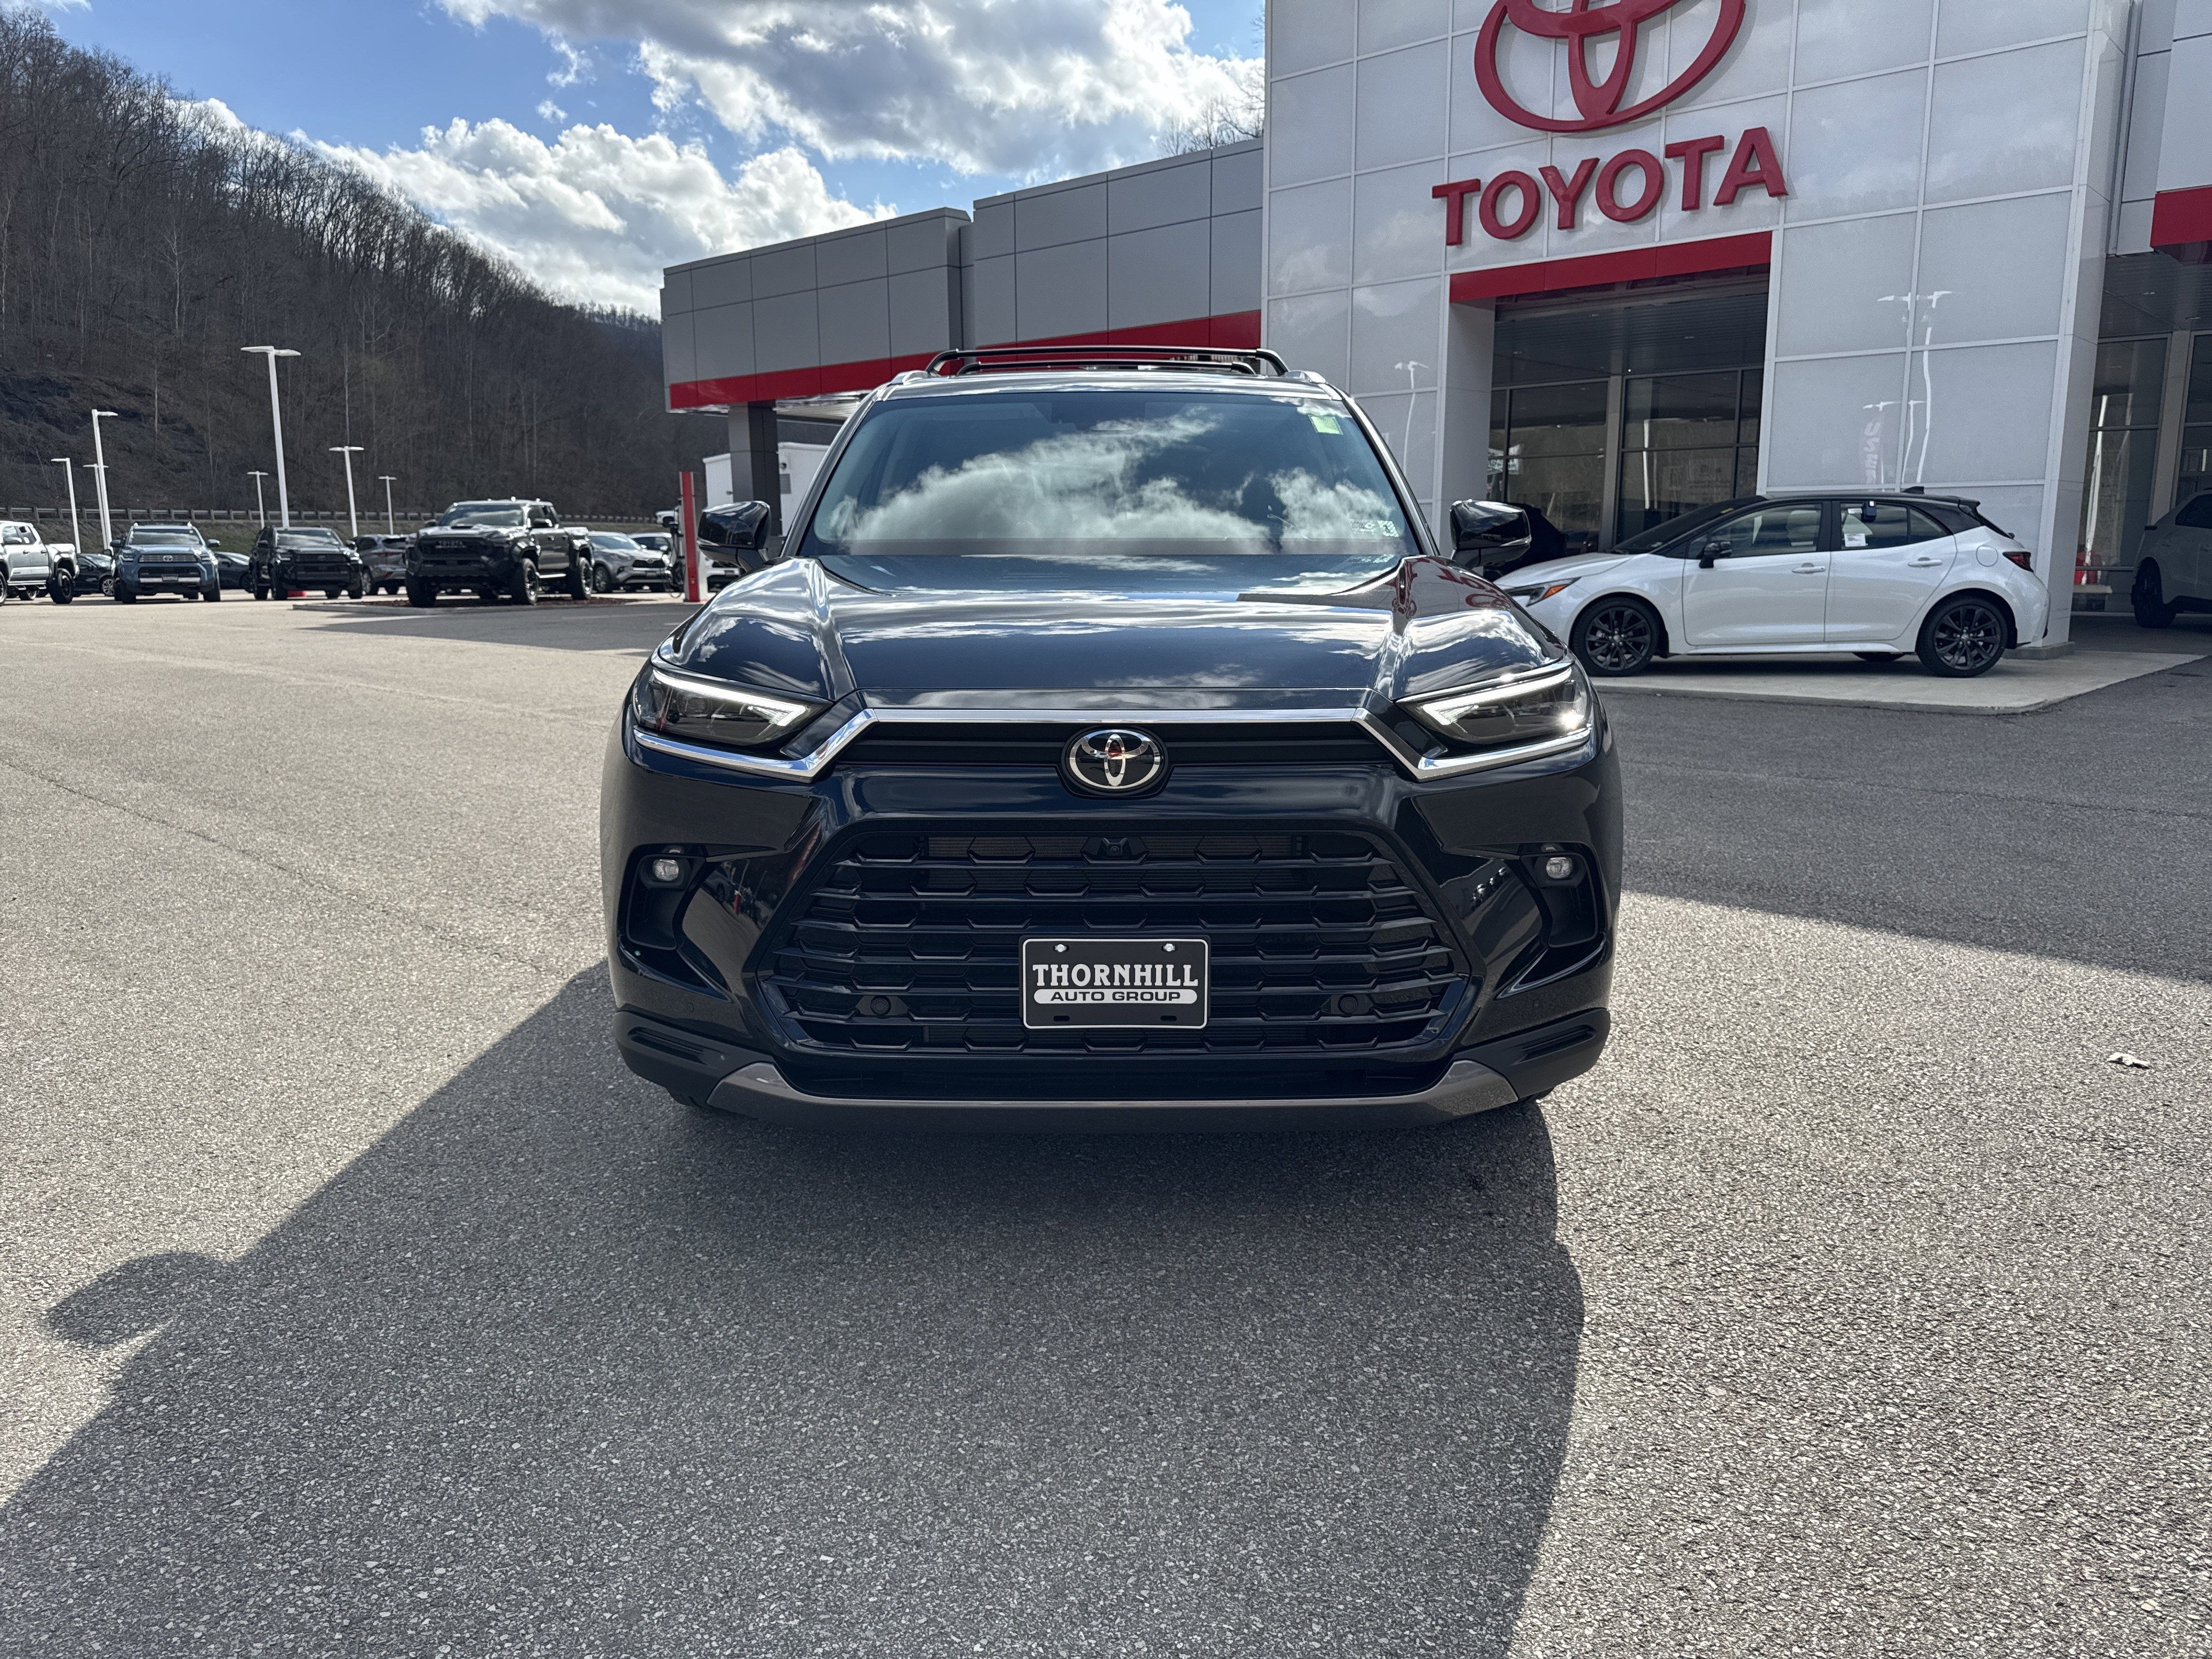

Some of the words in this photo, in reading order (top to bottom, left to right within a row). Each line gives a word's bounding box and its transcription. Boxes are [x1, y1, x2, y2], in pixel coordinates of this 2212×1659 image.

[1432, 127, 1787, 245] TOYOTA
[1032, 963, 1198, 987] THORNHILL
[1050, 991, 1105, 1001] AUTO
[1112, 991, 1181, 1001] GROUP
